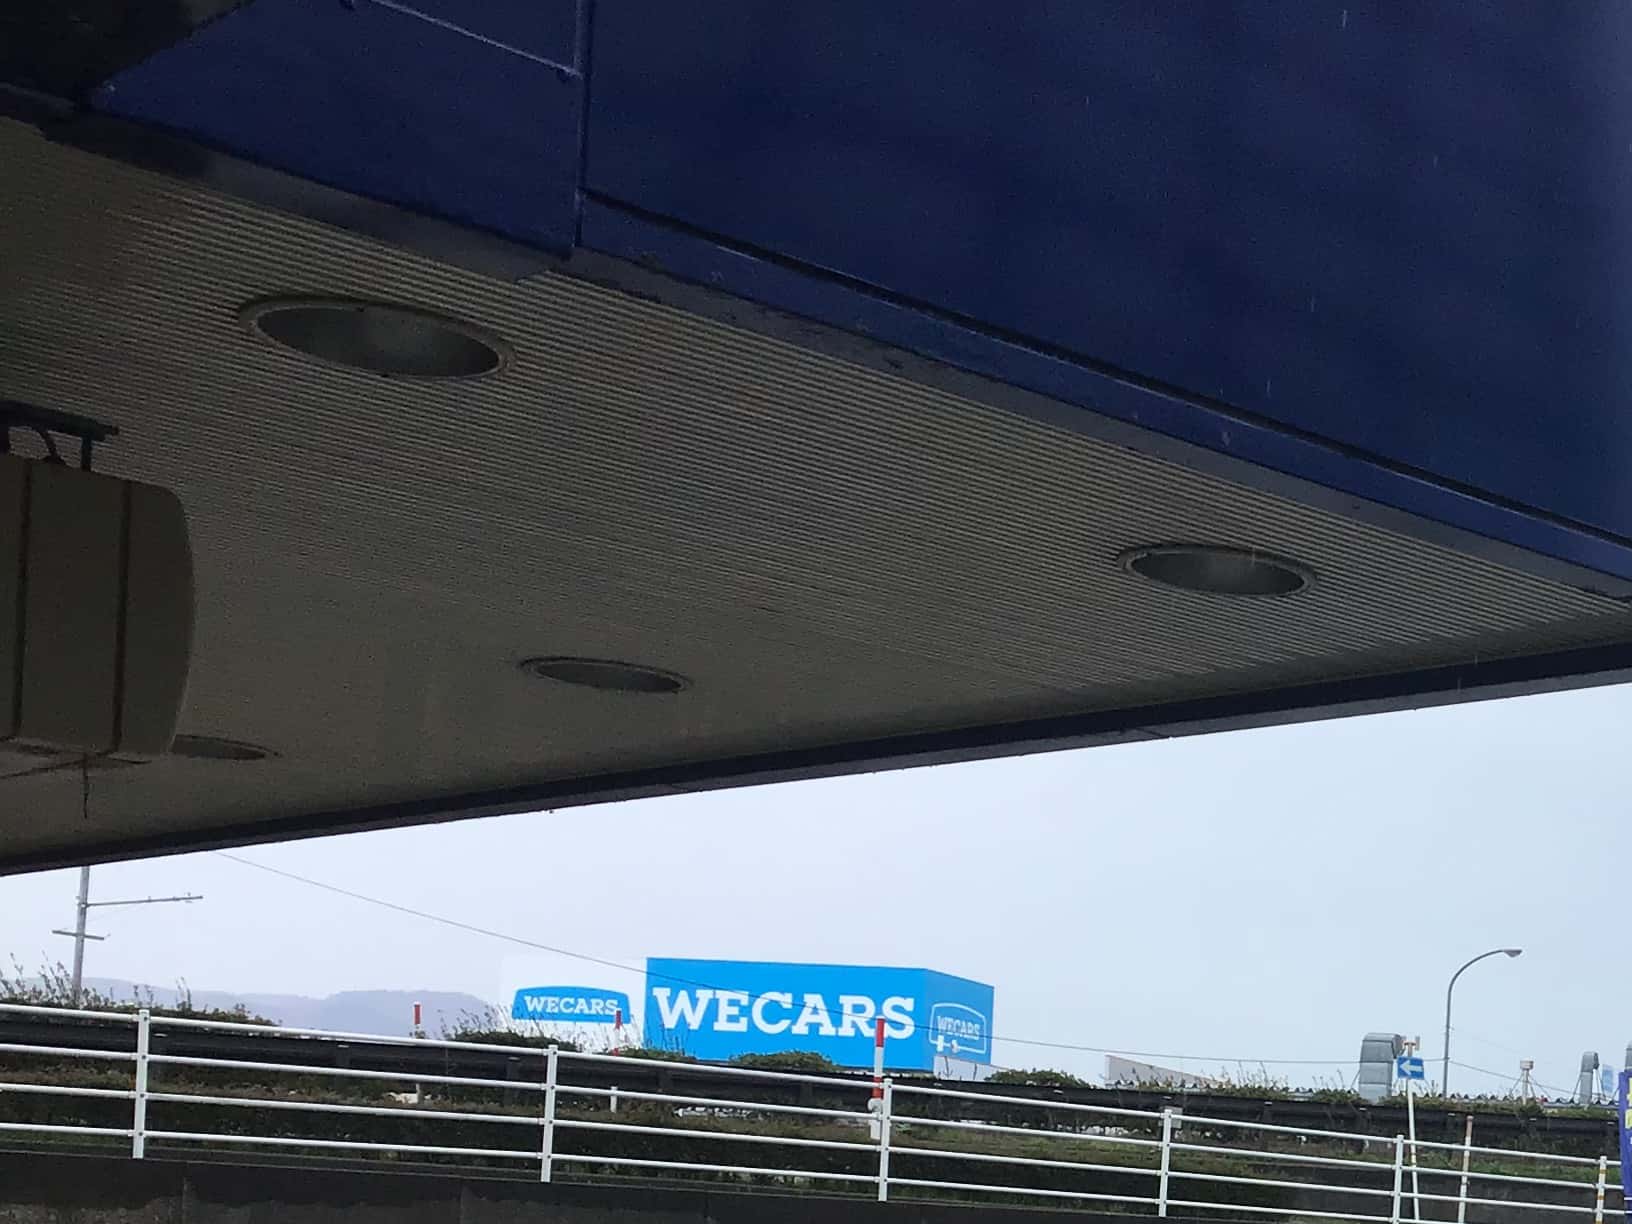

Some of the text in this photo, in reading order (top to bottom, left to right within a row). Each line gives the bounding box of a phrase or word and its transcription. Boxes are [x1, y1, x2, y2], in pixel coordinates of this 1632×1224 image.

[523, 995, 619, 1015] WECARS
[652, 987, 915, 1040] WECARS
[936, 1015, 980, 1040] WECARS
